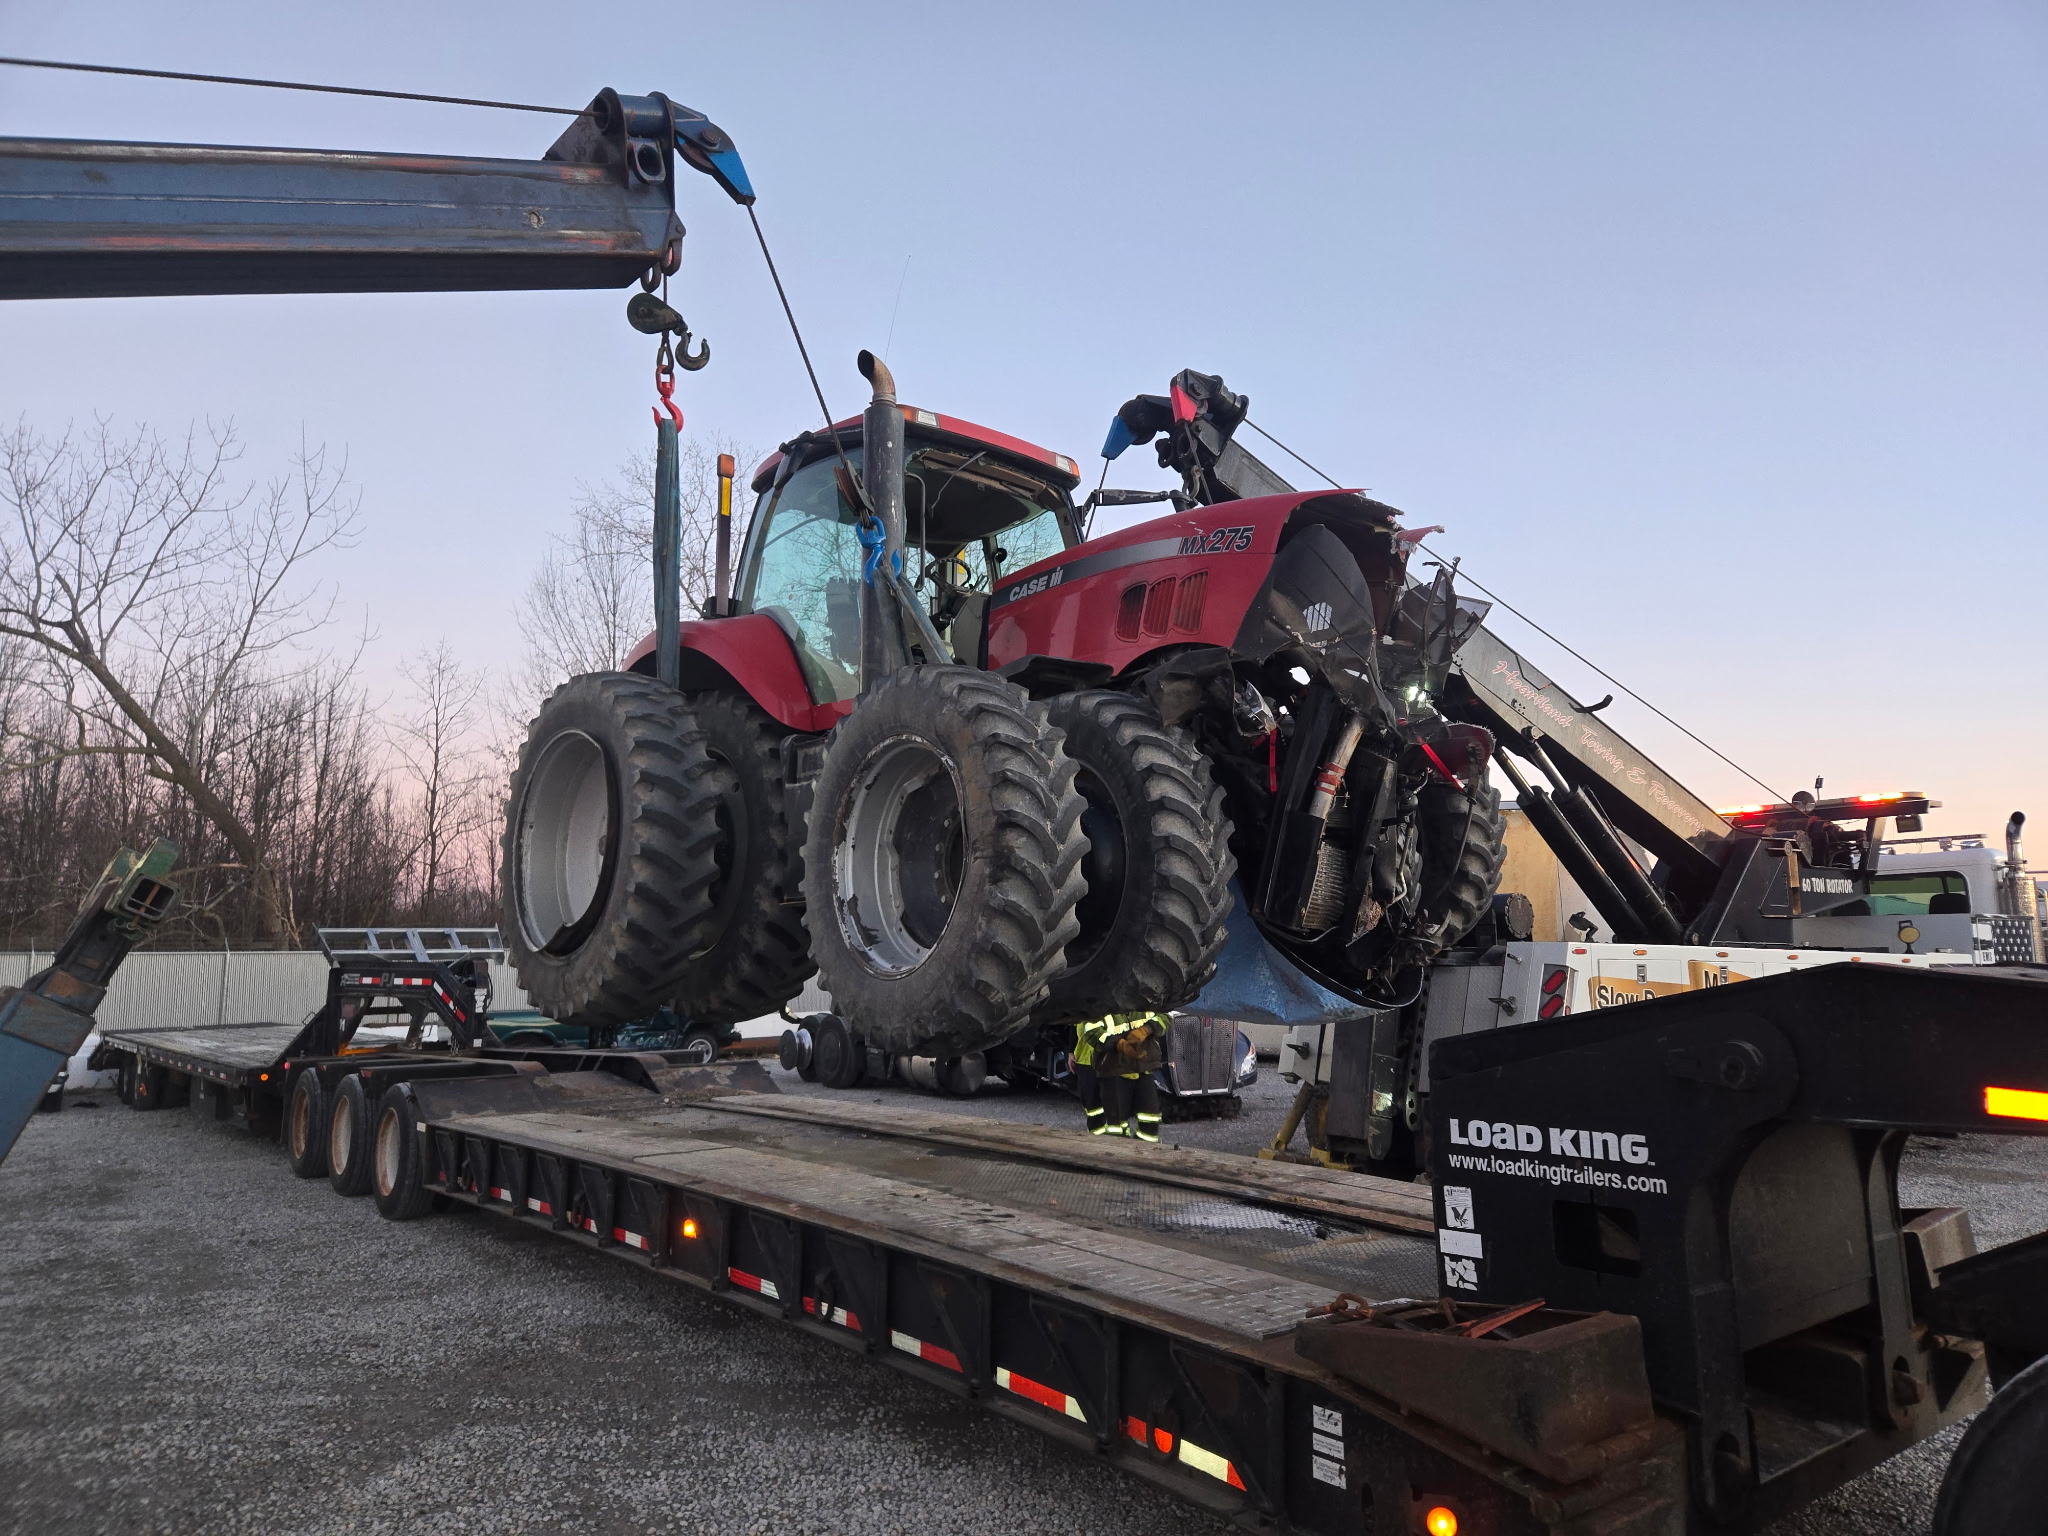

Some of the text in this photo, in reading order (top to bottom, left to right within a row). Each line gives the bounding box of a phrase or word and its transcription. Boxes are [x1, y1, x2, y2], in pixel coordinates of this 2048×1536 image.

[1178, 525, 1256, 555] MX275
[1009, 575, 1048, 602] CASE
[1492, 660, 1574, 727] Heartland
[1581, 724, 1624, 774] Towing
[1648, 780, 1706, 837] Recovery
[1802, 876, 1853, 894] 60 TON ROTATOR
[1448, 1154, 1668, 1195] www.loadkingtrailers.com
